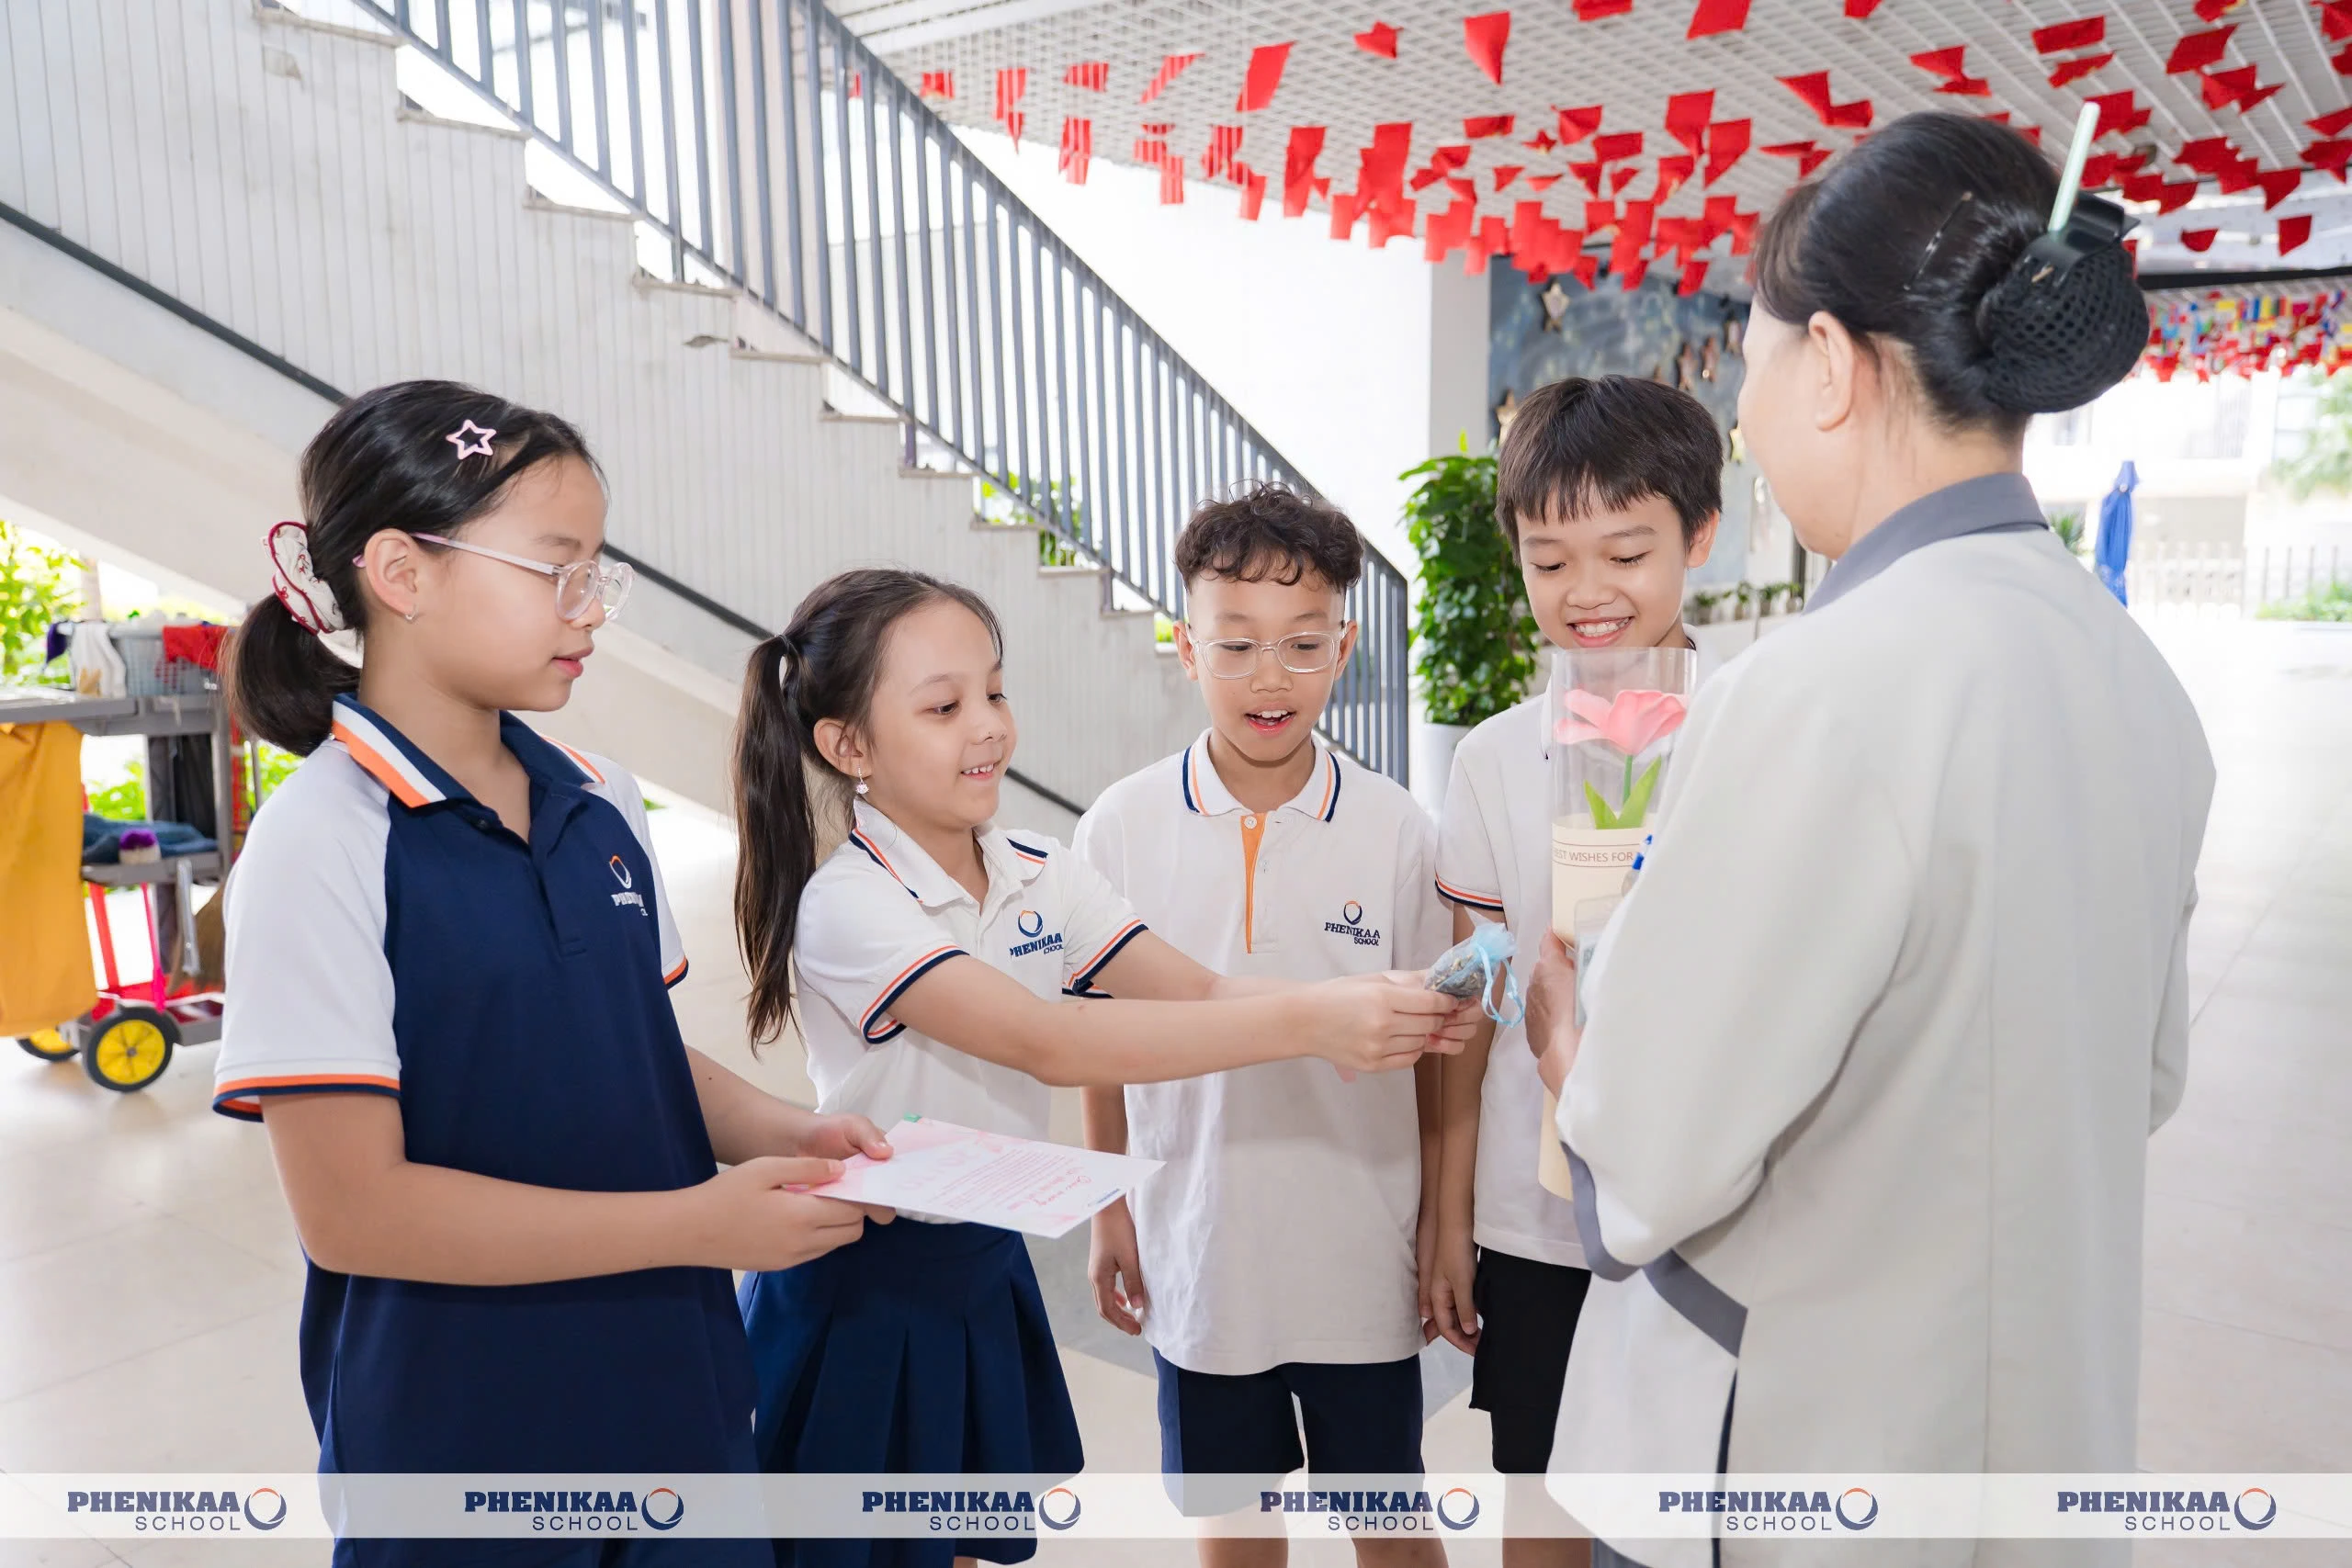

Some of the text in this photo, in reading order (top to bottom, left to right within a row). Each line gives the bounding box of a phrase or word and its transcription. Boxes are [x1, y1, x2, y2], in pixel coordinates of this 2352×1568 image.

[1569, 852, 1609, 863] WISHES
[1611, 852, 1634, 862] FOR
[1324, 922, 1381, 939] PHENIKAA
[1353, 937, 1379, 946] SCHOOL
